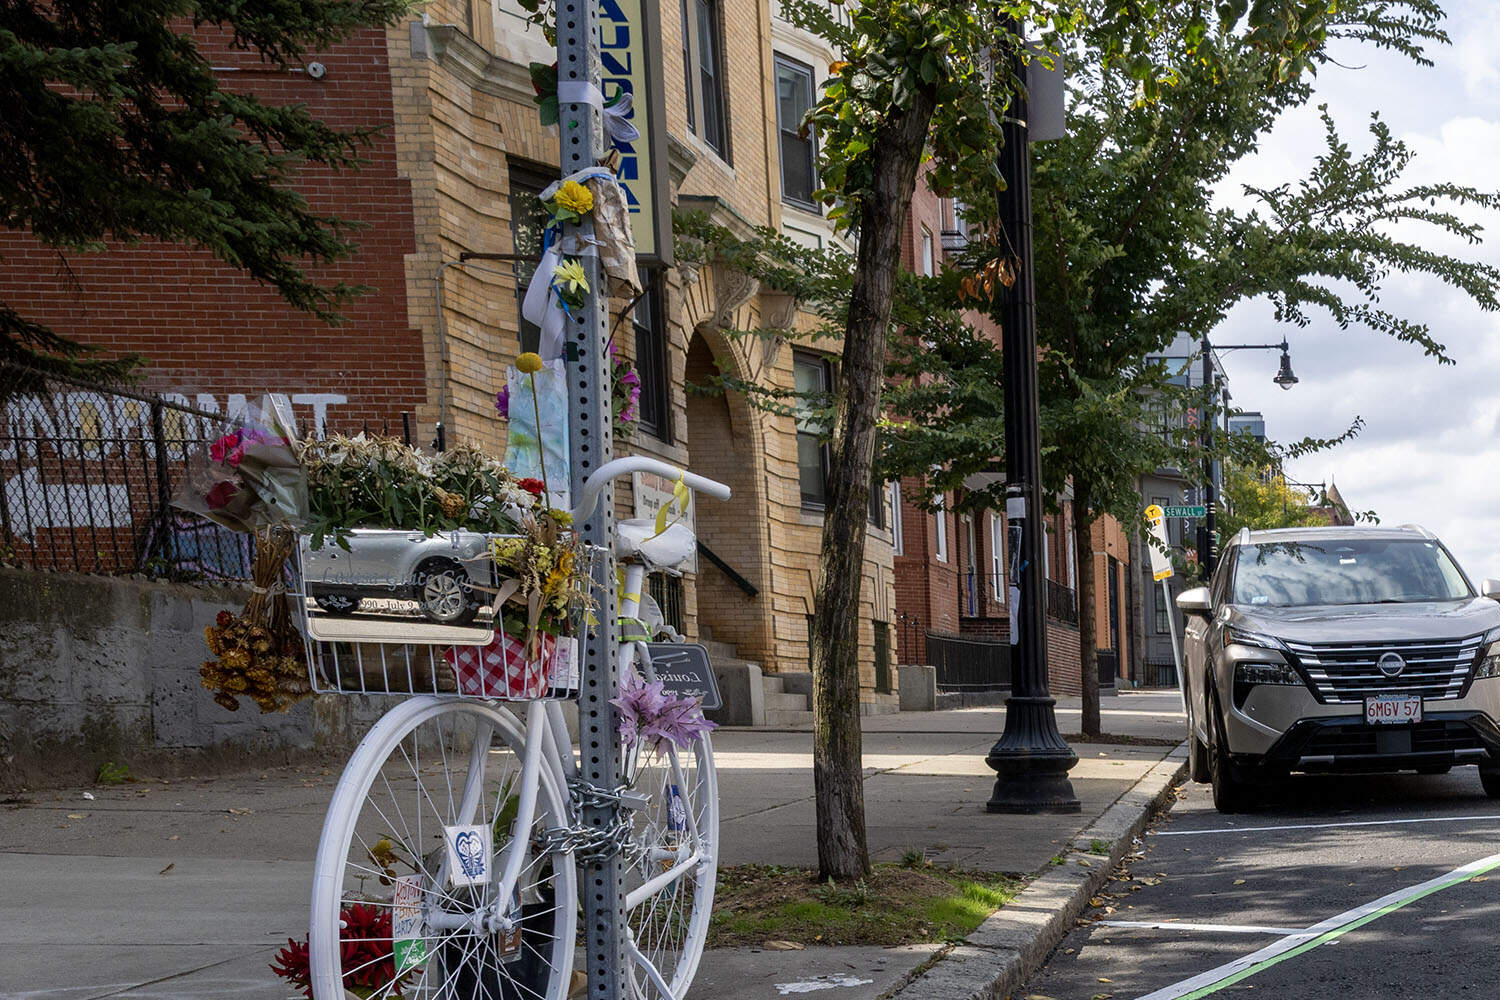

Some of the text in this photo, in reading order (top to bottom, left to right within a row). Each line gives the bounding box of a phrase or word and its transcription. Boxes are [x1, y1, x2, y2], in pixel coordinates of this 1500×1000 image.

[1166, 508, 1195, 516] SEWALL
[387, 600, 405, 611] July
[1368, 701, 1420, 717] 6MGV 57
